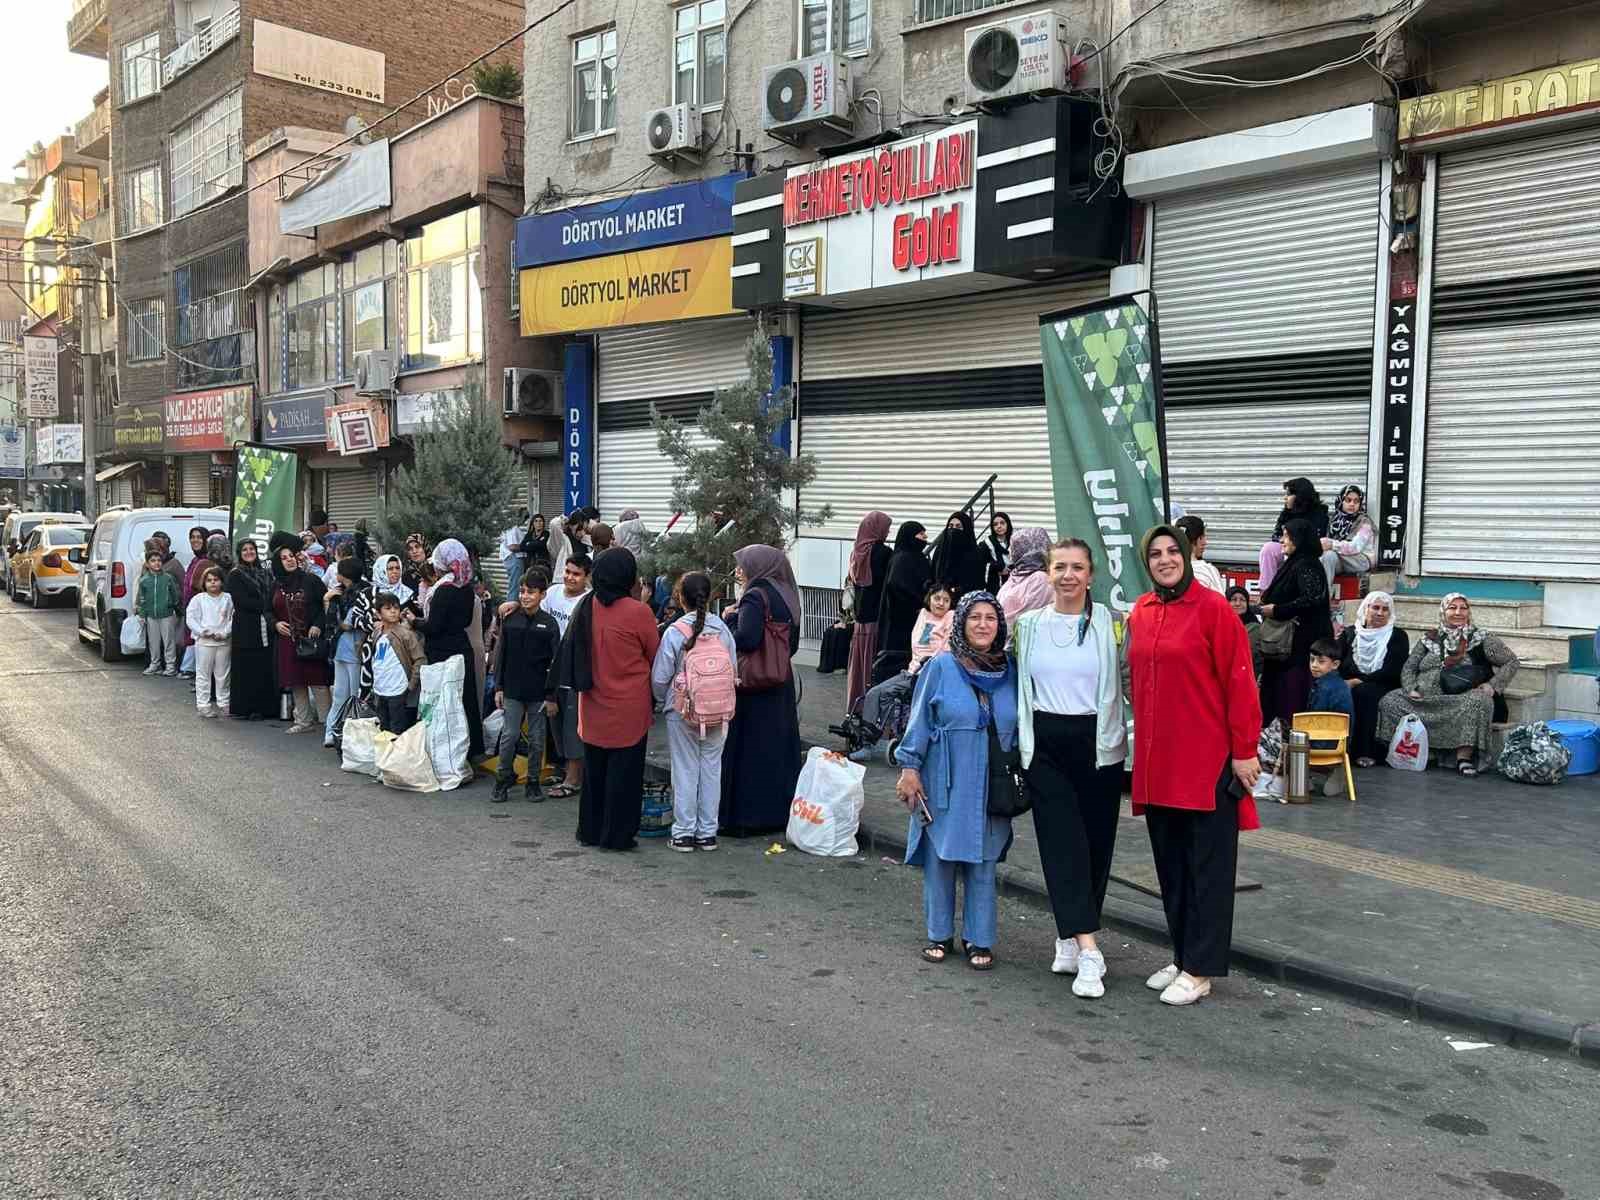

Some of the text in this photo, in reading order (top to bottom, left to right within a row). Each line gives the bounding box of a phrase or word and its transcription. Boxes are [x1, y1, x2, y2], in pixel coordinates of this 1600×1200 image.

[294, 73, 315, 84] Tel:
[320, 80, 344, 92] 233
[813, 63, 823, 111] VESTEL
[1454, 63, 1599, 128] FIRAT
[783, 130, 975, 229] MEHMETOĞULLARI
[562, 203, 685, 246] DÖRTYOL MARKET
[893, 201, 963, 272] Gold
[561, 268, 691, 307] DÖRTYOL MARKET
[1389, 304, 1411, 405] YAĞMUR
[348, 422, 369, 446] E
[1383, 425, 1405, 560] İLETİŞİM
